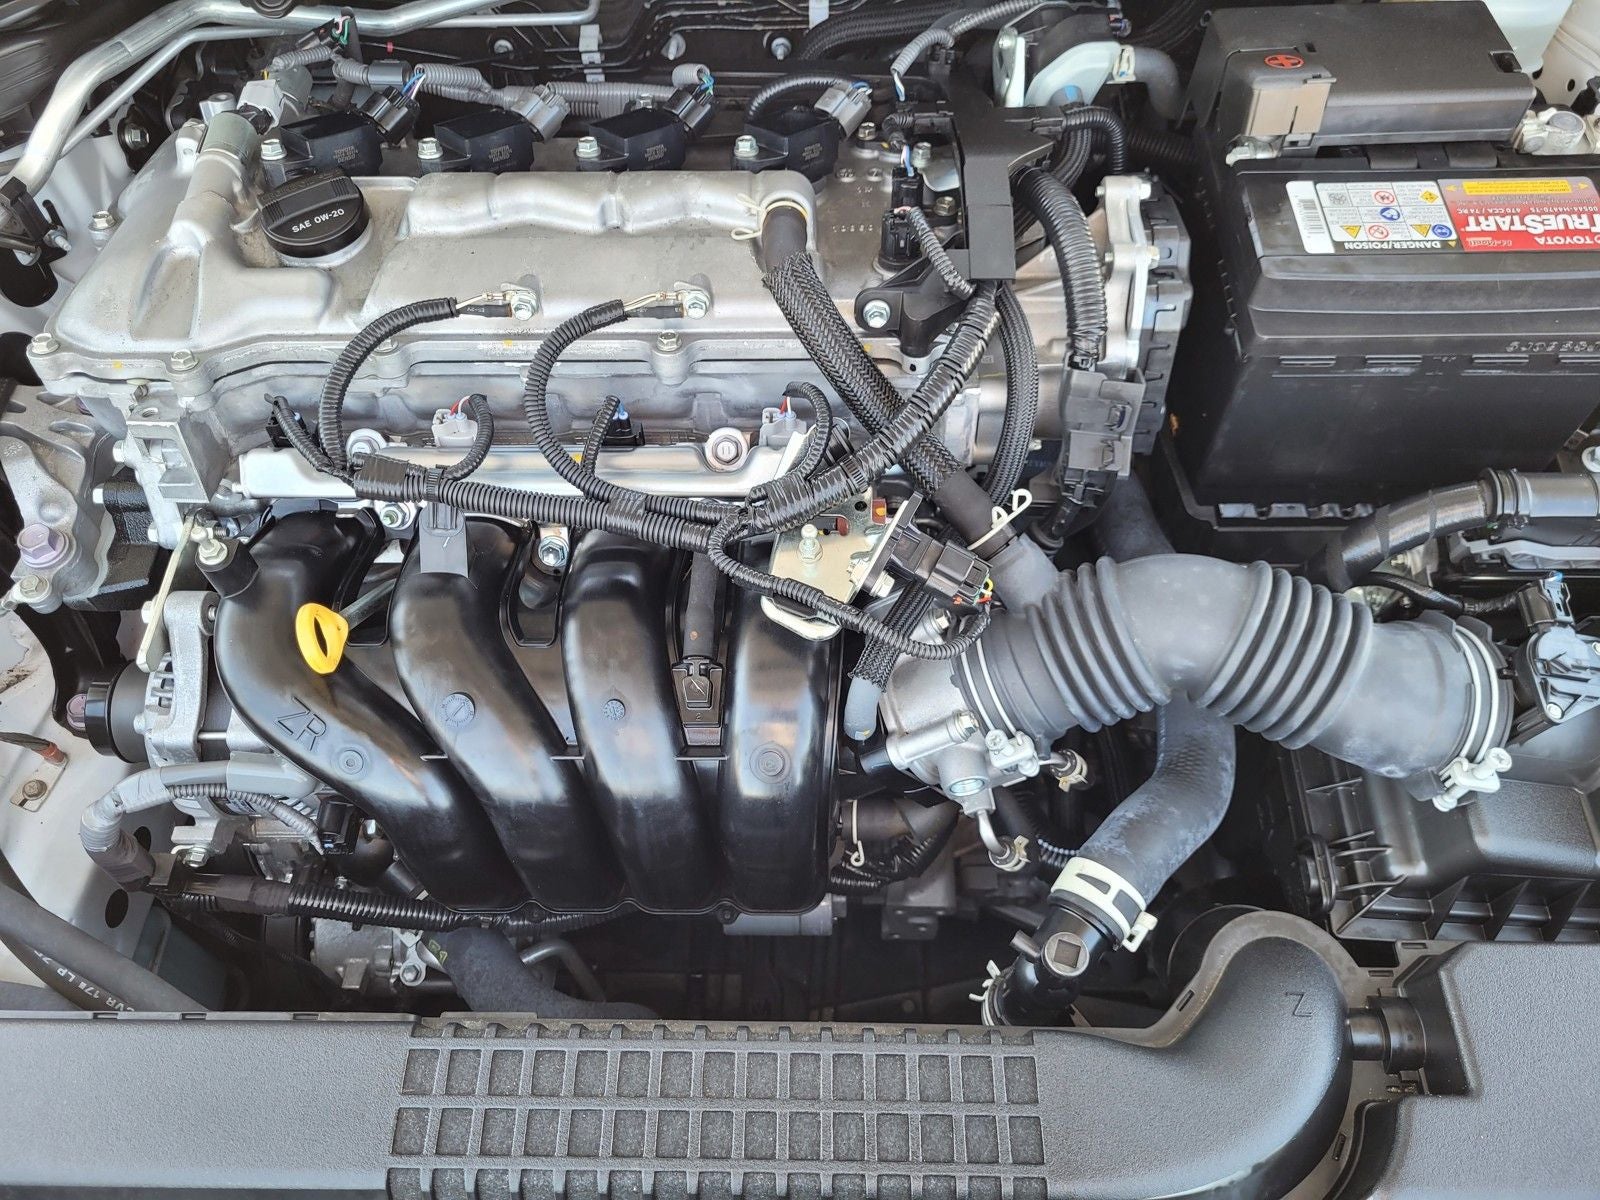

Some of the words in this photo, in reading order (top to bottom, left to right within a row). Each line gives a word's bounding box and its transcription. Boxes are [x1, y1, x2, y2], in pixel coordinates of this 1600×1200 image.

[291, 219, 312, 233] SAE
[313, 208, 345, 224] 0W-20
[1465, 214, 1600, 235] TRUESTART
[1343, 240, 1441, 250] DANGER/POISON
[1533, 235, 1594, 246] TOYOTA
[272, 695, 327, 752] ZR
[56, 967, 77, 983] LP
